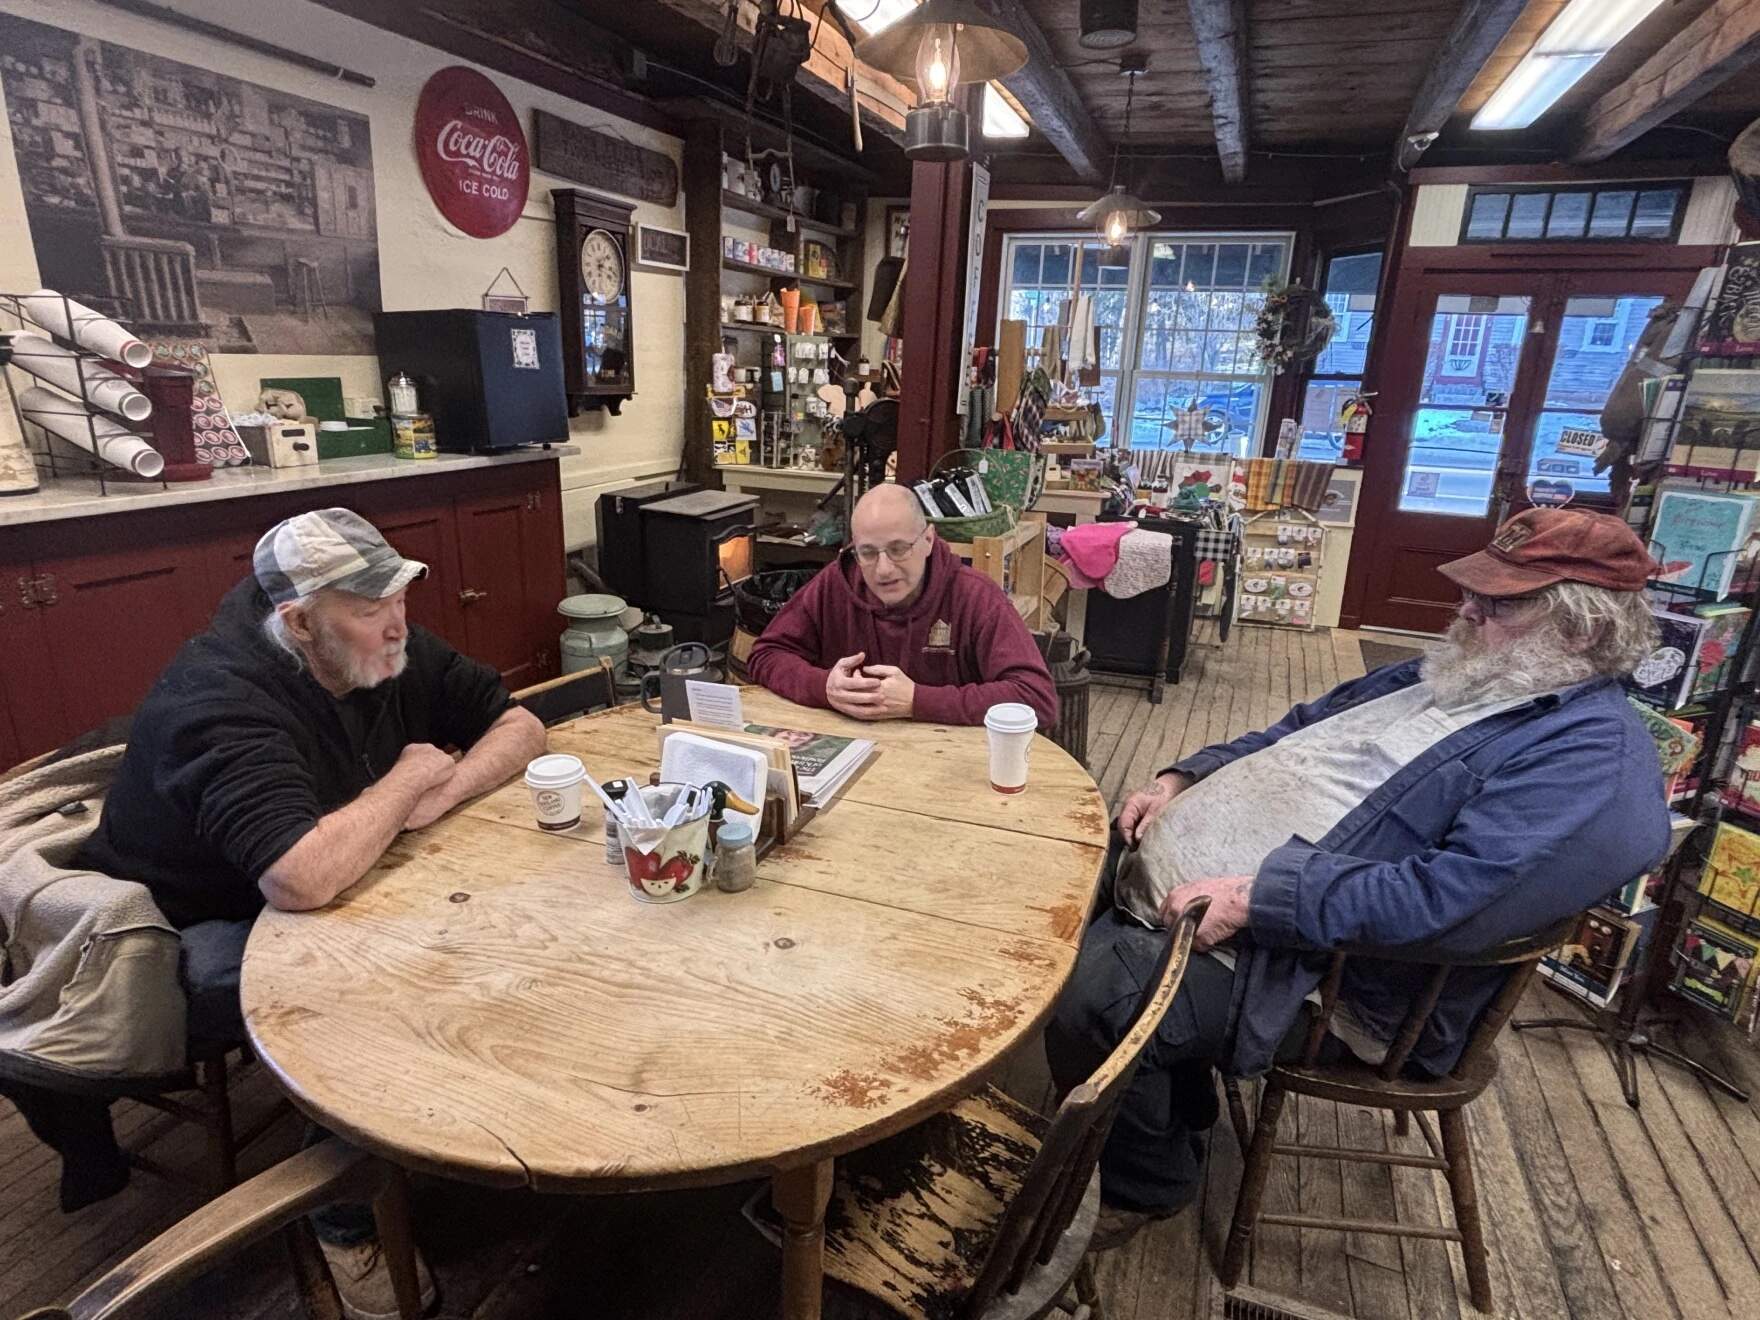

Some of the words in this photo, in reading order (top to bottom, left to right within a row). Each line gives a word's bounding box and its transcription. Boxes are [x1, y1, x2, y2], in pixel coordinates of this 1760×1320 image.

[464, 105, 498, 124] DRINK
[436, 120, 520, 180] Coca-Cola
[459, 180, 479, 195] ICE
[482, 184, 509, 200] COLD
[1560, 430, 1595, 447] CLOSED
